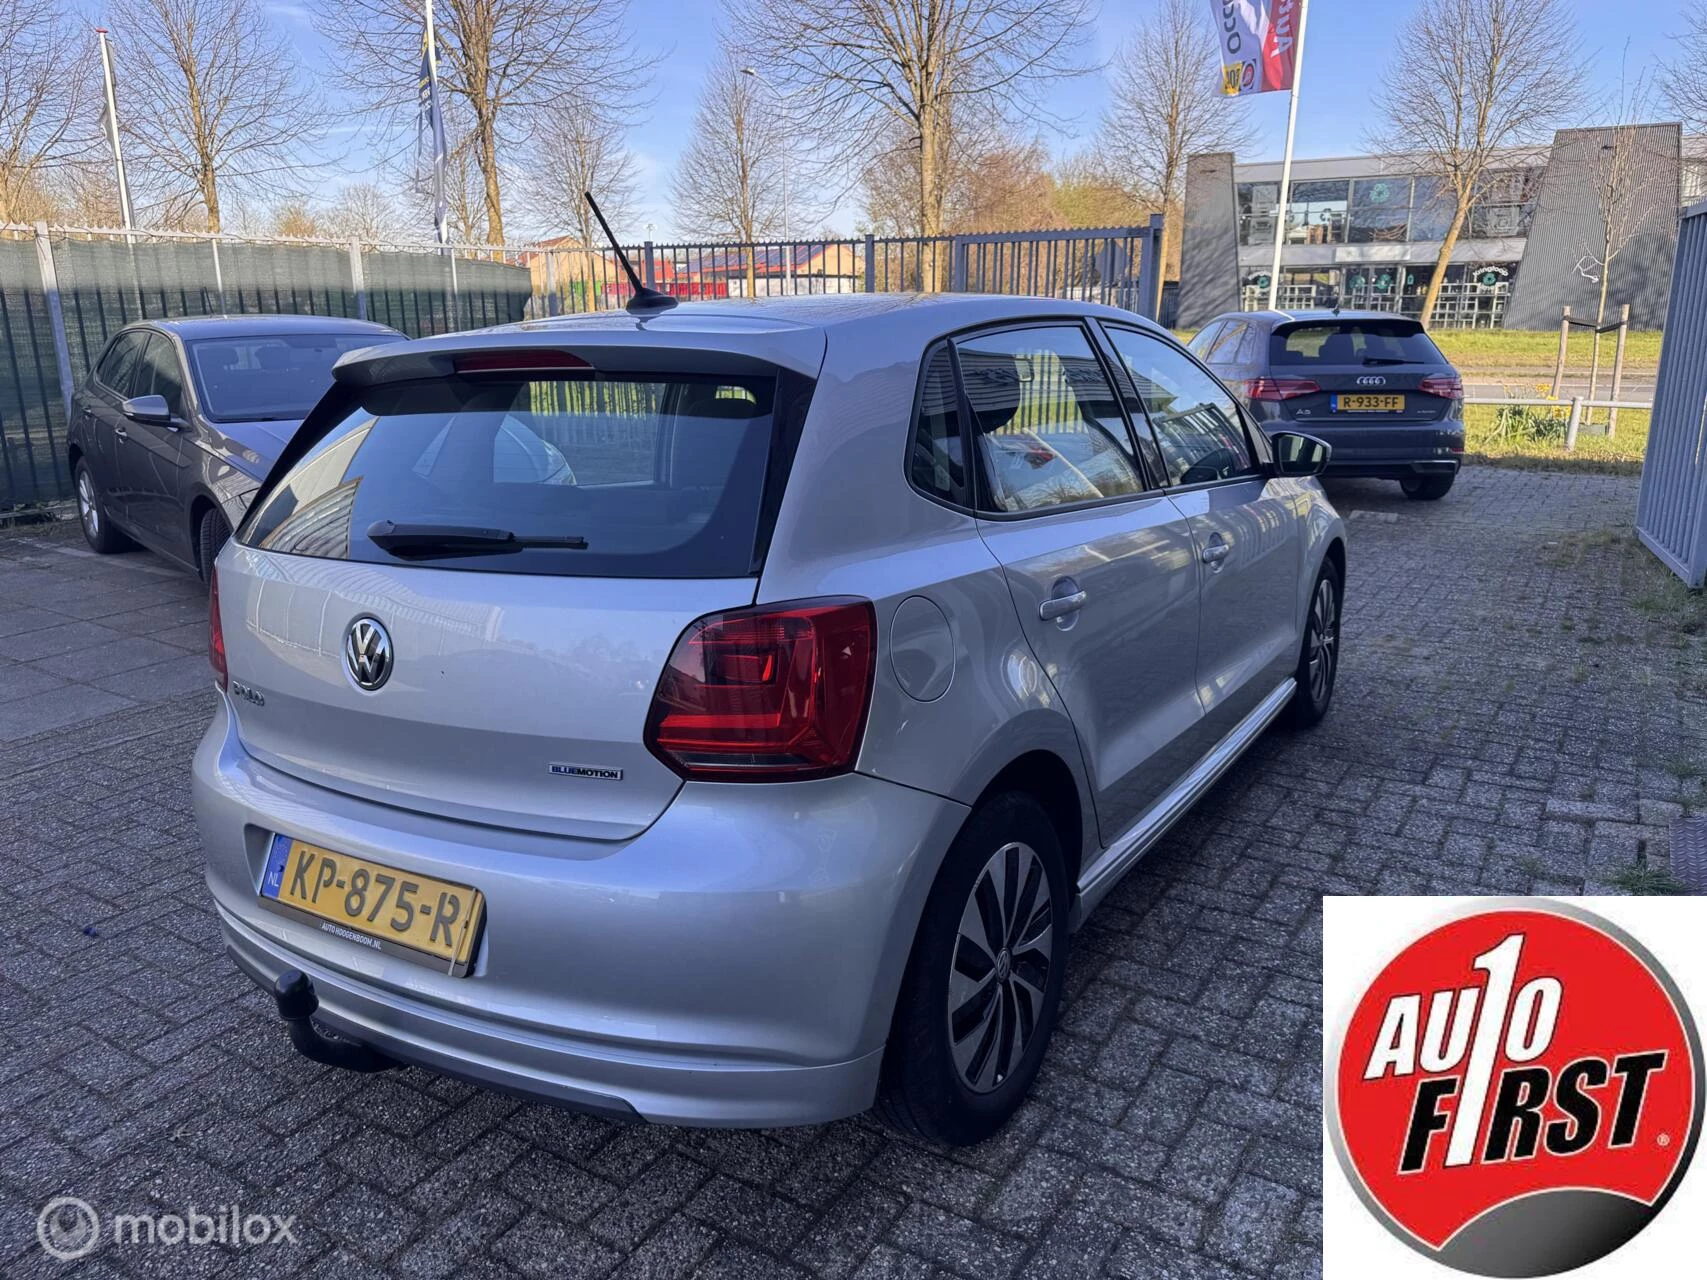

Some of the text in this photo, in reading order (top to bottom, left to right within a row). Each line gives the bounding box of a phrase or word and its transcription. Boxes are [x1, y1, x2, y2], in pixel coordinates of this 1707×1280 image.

[1343, 396, 1399, 408] R-933-FF
[551, 765, 618, 779] BLUEMOTION
[267, 870, 281, 888] NL
[289, 850, 461, 948] KP-875-R
[321, 922, 336, 934] AUTO
